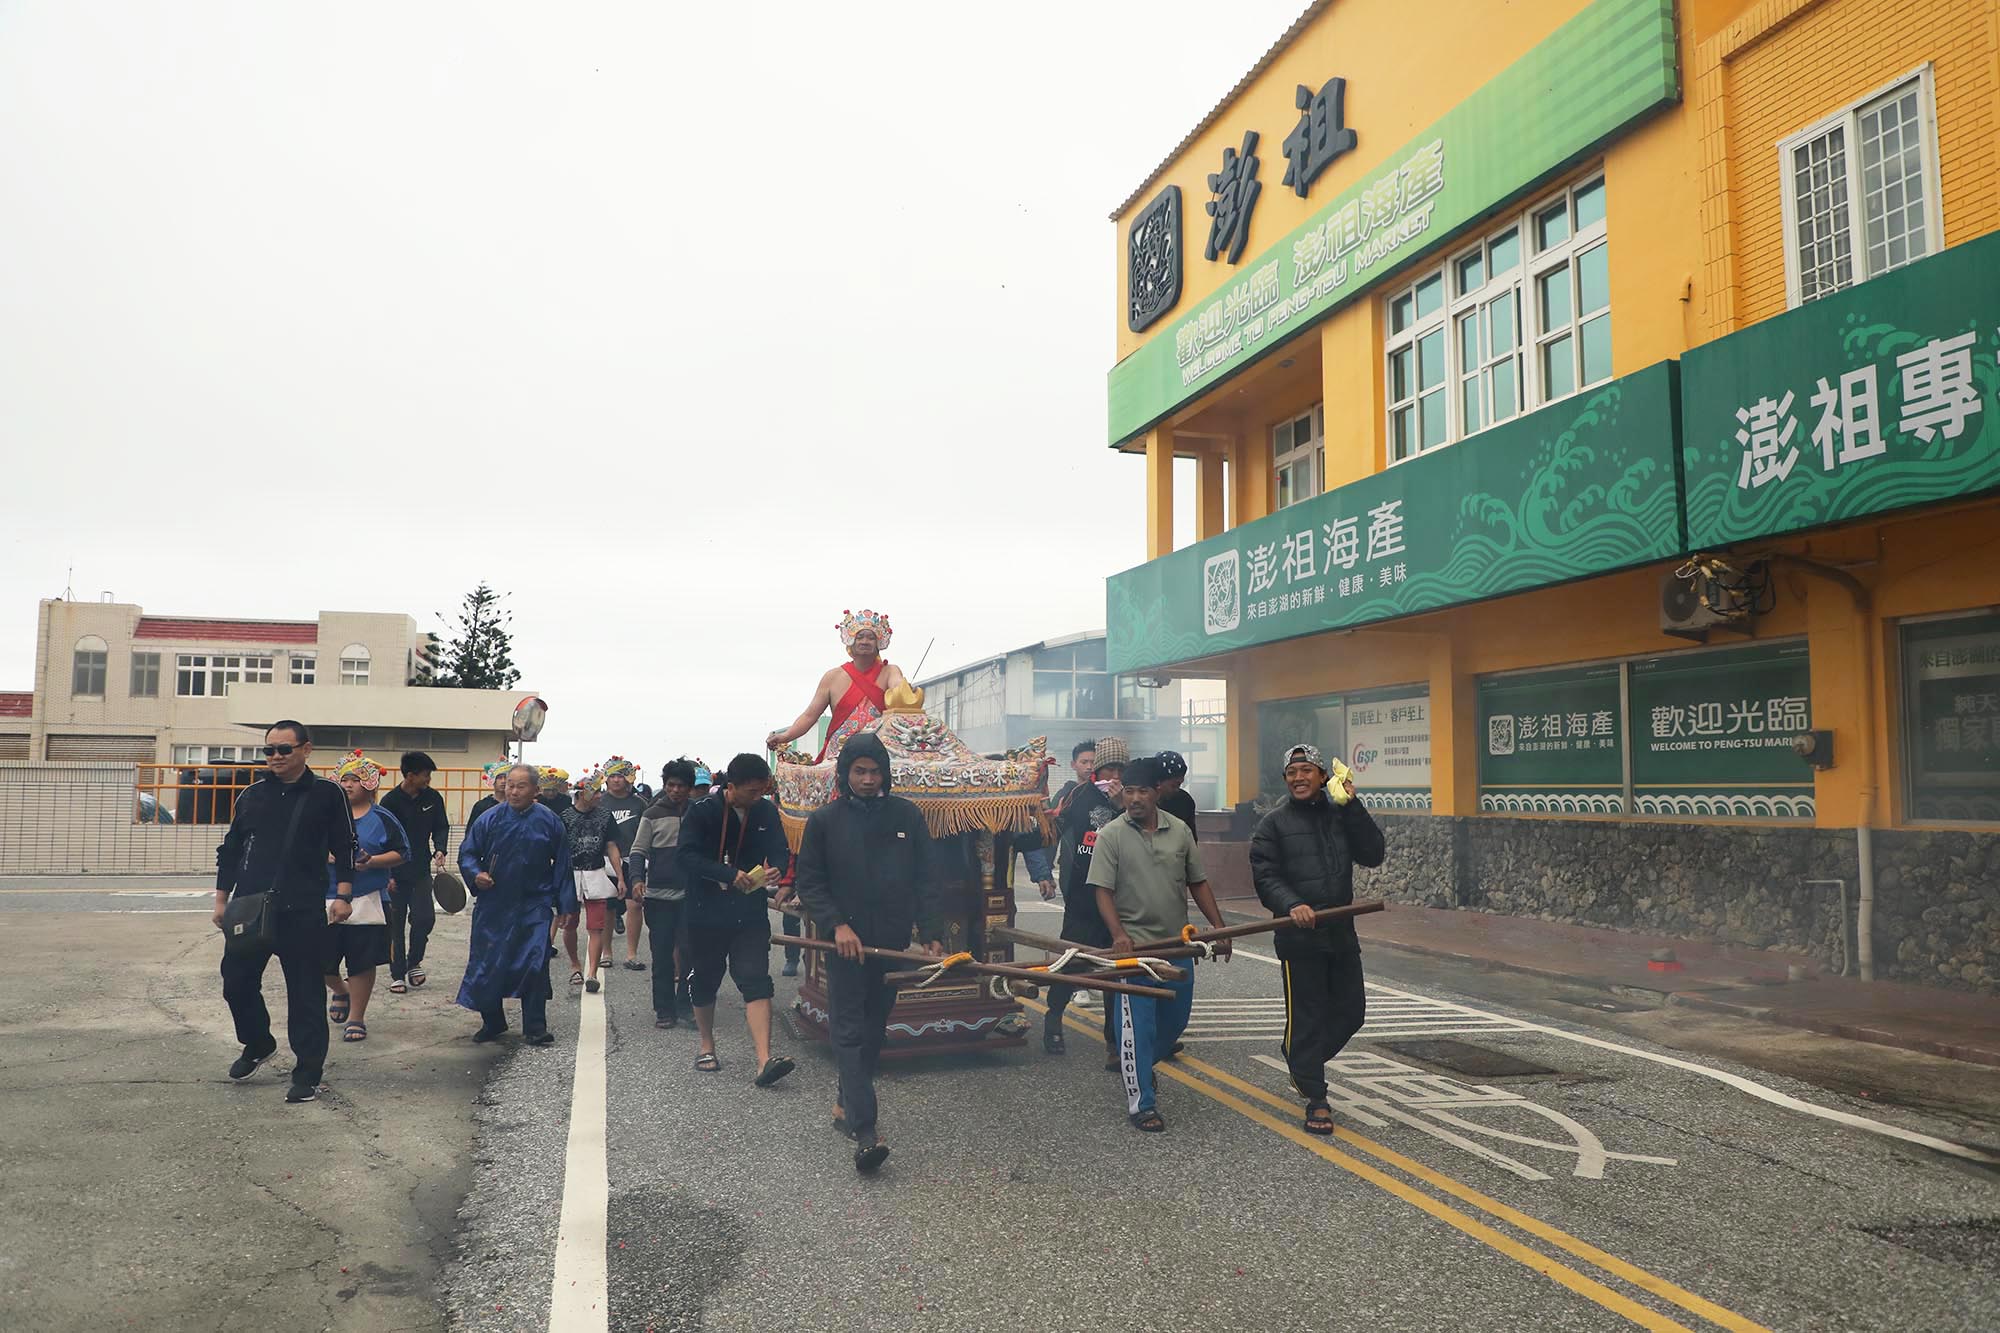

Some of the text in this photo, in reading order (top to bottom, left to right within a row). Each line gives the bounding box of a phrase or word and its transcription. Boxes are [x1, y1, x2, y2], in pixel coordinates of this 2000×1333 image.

[1204, 76, 1358, 265] 澎祖
[1176, 138, 1444, 367] 歡迎光臨 澎祖海產
[1182, 330, 1241, 386] WELCOME
[1243, 316, 1263, 345] TO
[1354, 200, 1434, 274] MARKET
[1734, 318, 2000, 490] 澎祖專
[1246, 499, 1406, 595] 澎祖海產
[1518, 710, 1614, 739] 澎祖海產
[1651, 697, 1808, 738] 歡迎光臨
[1953, 692, 2000, 714] 純天
[1357, 750, 1378, 764] GSP
[1651, 737, 1793, 751] WELCOME TO PENG-TSU MAR
[1077, 844, 1094, 855] KUL
[1123, 995, 1138, 1097] SYA GROUP
